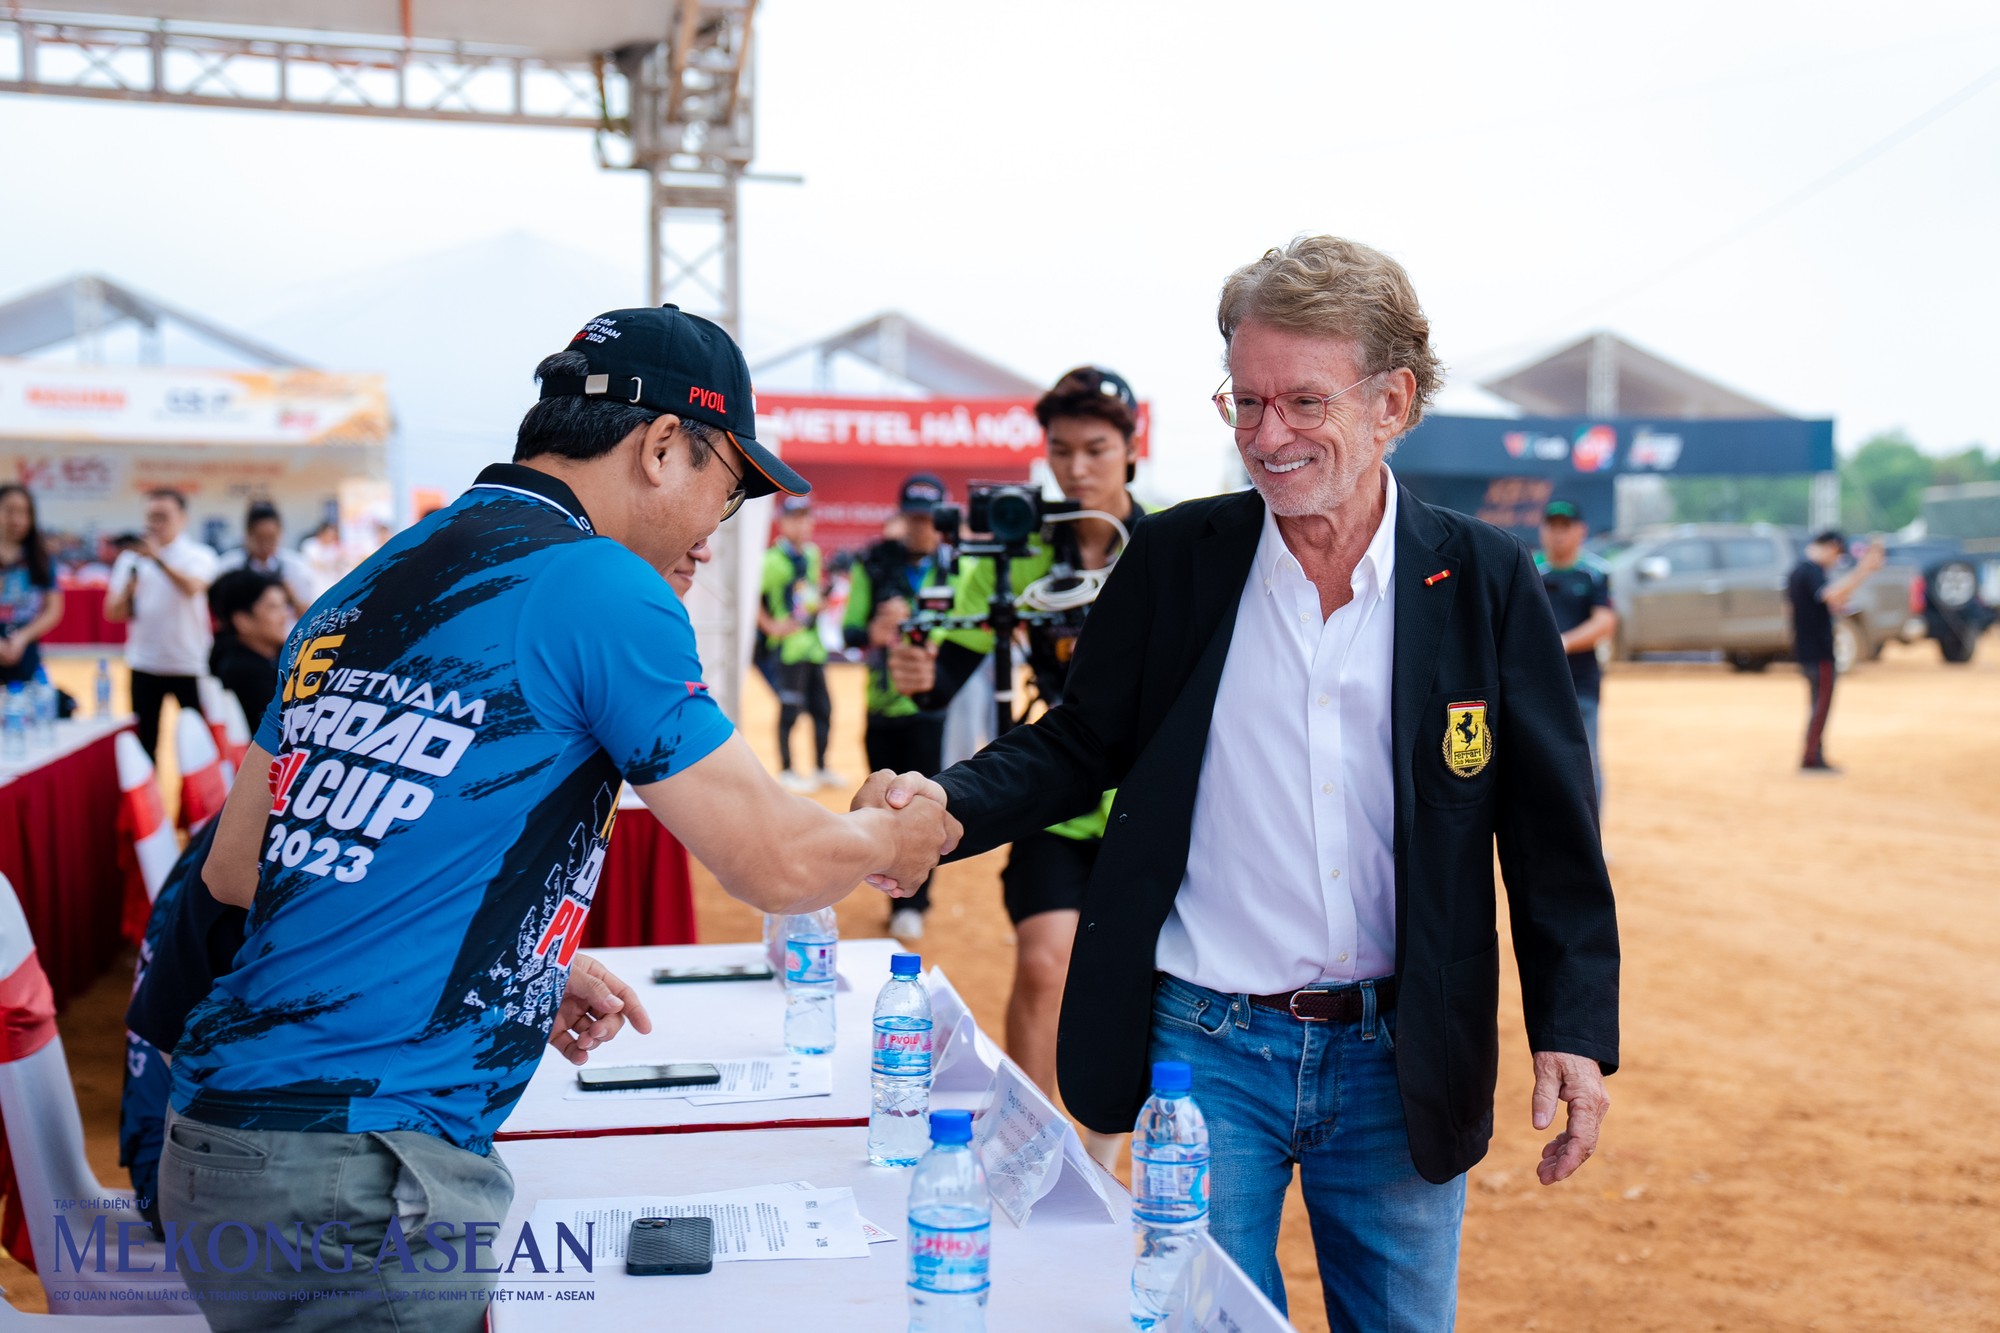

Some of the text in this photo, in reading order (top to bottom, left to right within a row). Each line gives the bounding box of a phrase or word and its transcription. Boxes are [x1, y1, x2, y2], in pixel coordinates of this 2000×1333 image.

[585, 332, 607, 344] 2023
[598, 326, 622, 339] NAM
[689, 386, 727, 414] PVOIL
[323, 667, 487, 726] VIETNAM
[292, 758, 435, 840] CUP
[265, 823, 375, 884] 2023
[890, 1034, 919, 1045] PVOIL
